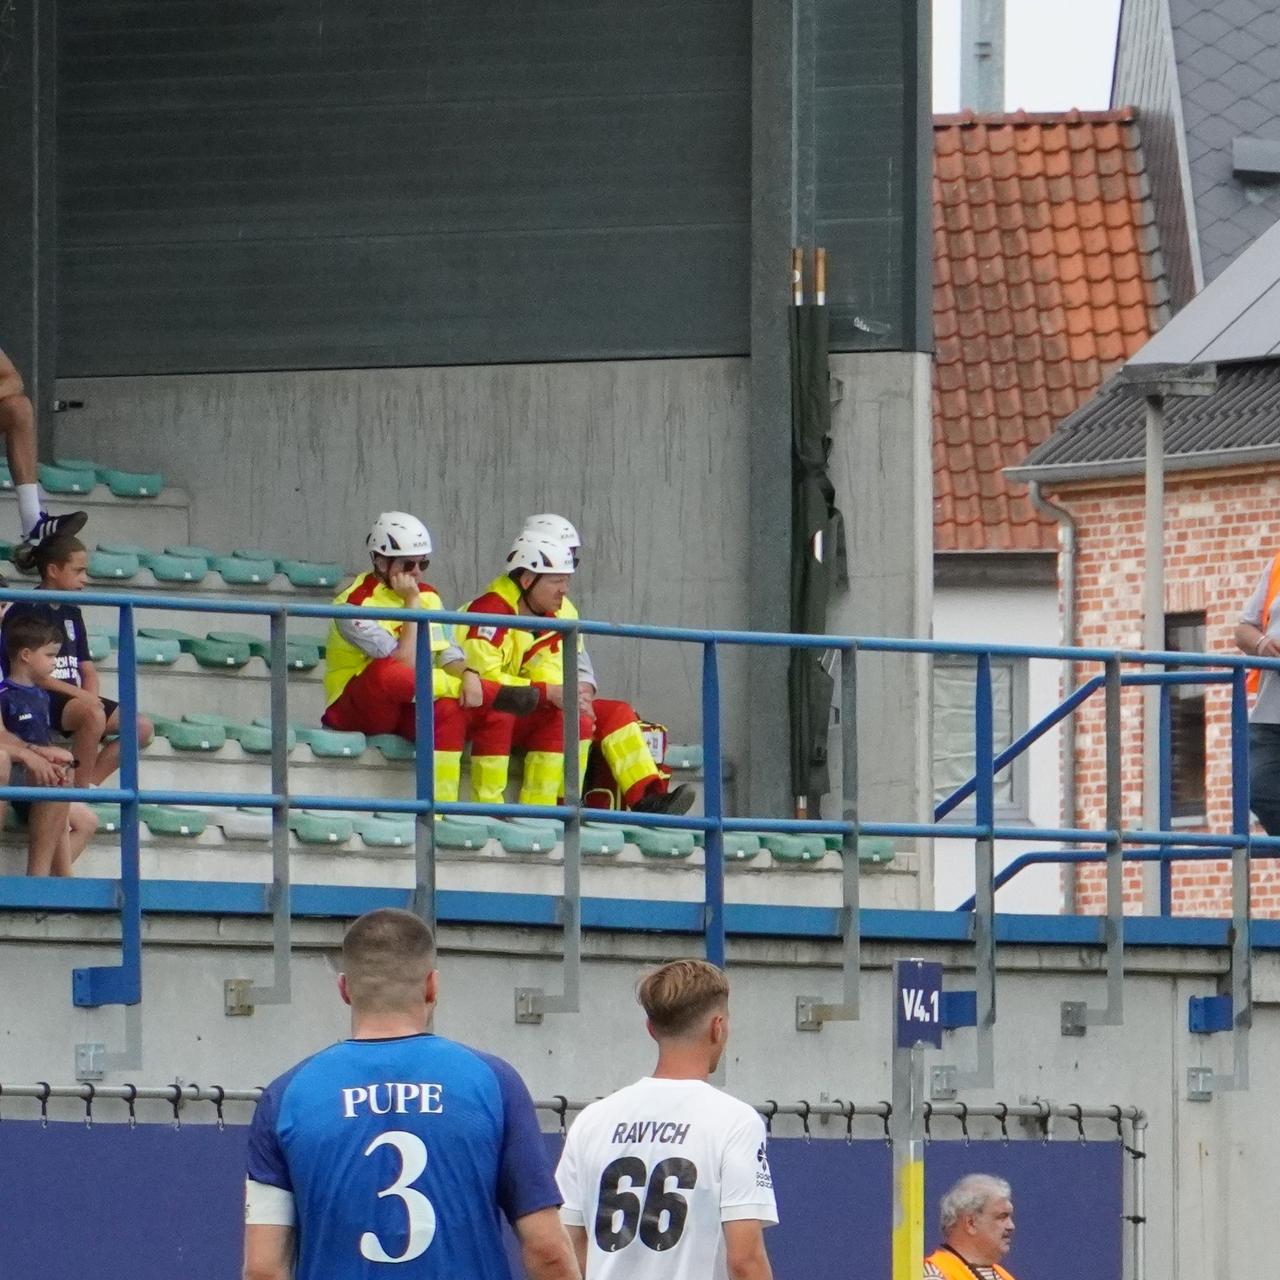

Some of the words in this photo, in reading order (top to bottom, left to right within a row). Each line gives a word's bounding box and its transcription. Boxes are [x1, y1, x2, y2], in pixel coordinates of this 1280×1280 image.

[902, 988, 940, 1023] V4.1
[342, 1083, 443, 1118] PUPE
[612, 1121, 691, 1145] RAVYCH
[360, 1131, 437, 1263] 3
[595, 1156, 698, 1252] 66
